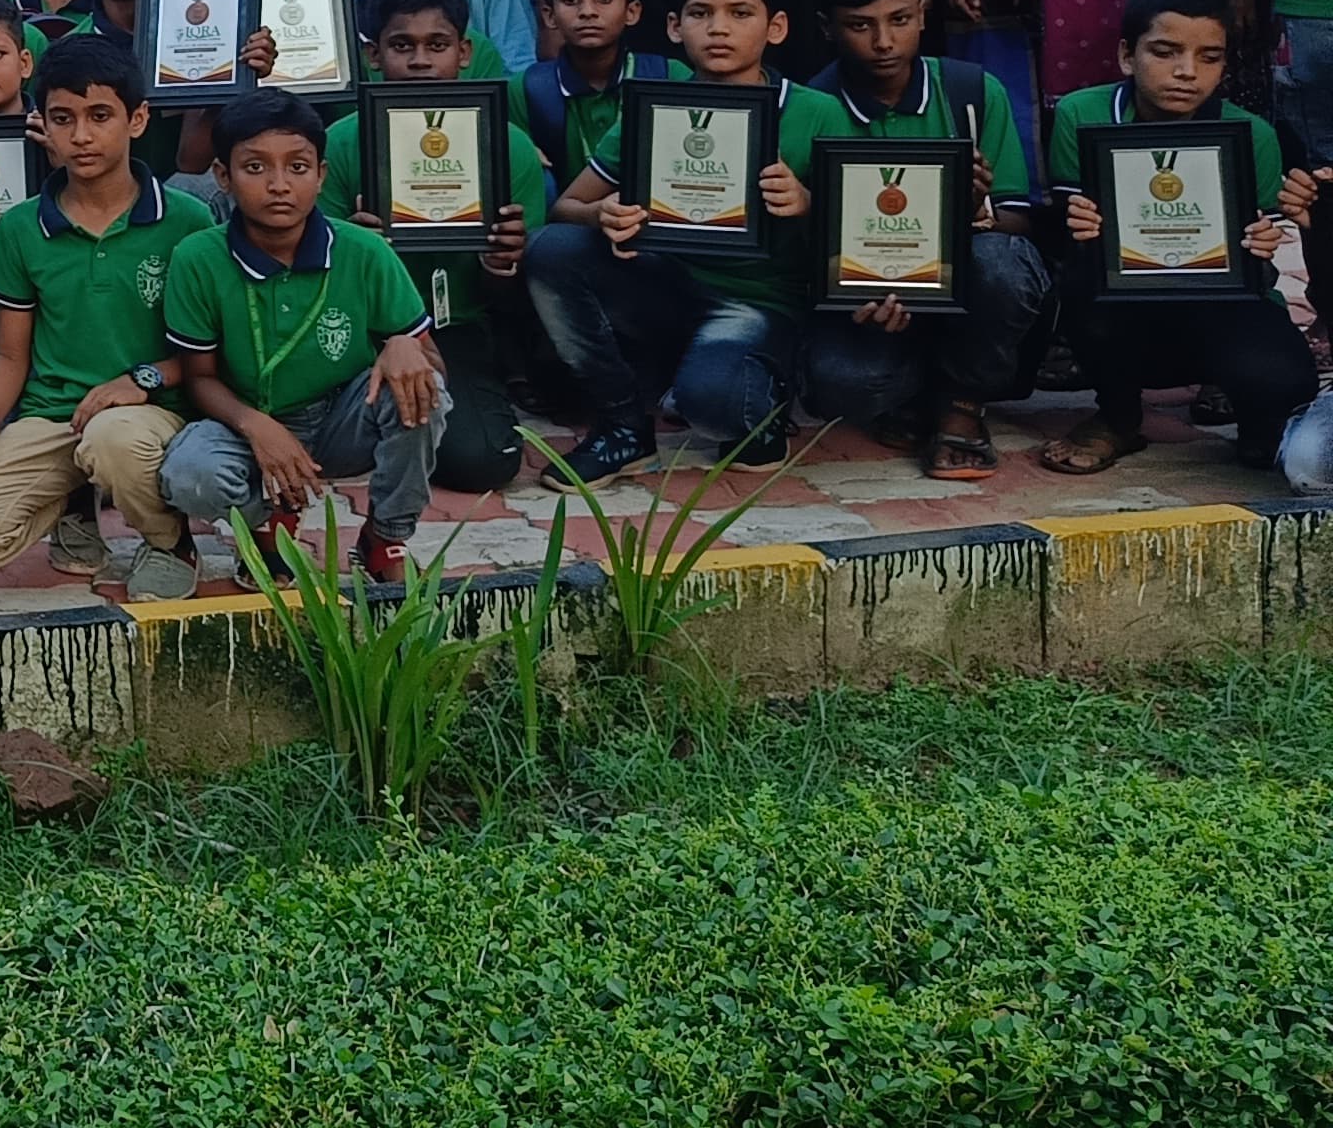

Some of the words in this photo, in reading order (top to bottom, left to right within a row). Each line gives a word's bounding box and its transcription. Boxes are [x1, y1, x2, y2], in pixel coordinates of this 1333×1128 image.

[185, 25, 220, 38] IQRA
[283, 25, 320, 39] IQRA
[423, 158, 465, 174] IQRA
[685, 158, 729, 175] IQRA
[1153, 202, 1203, 217] IQRA
[878, 216, 923, 232] IQRA
